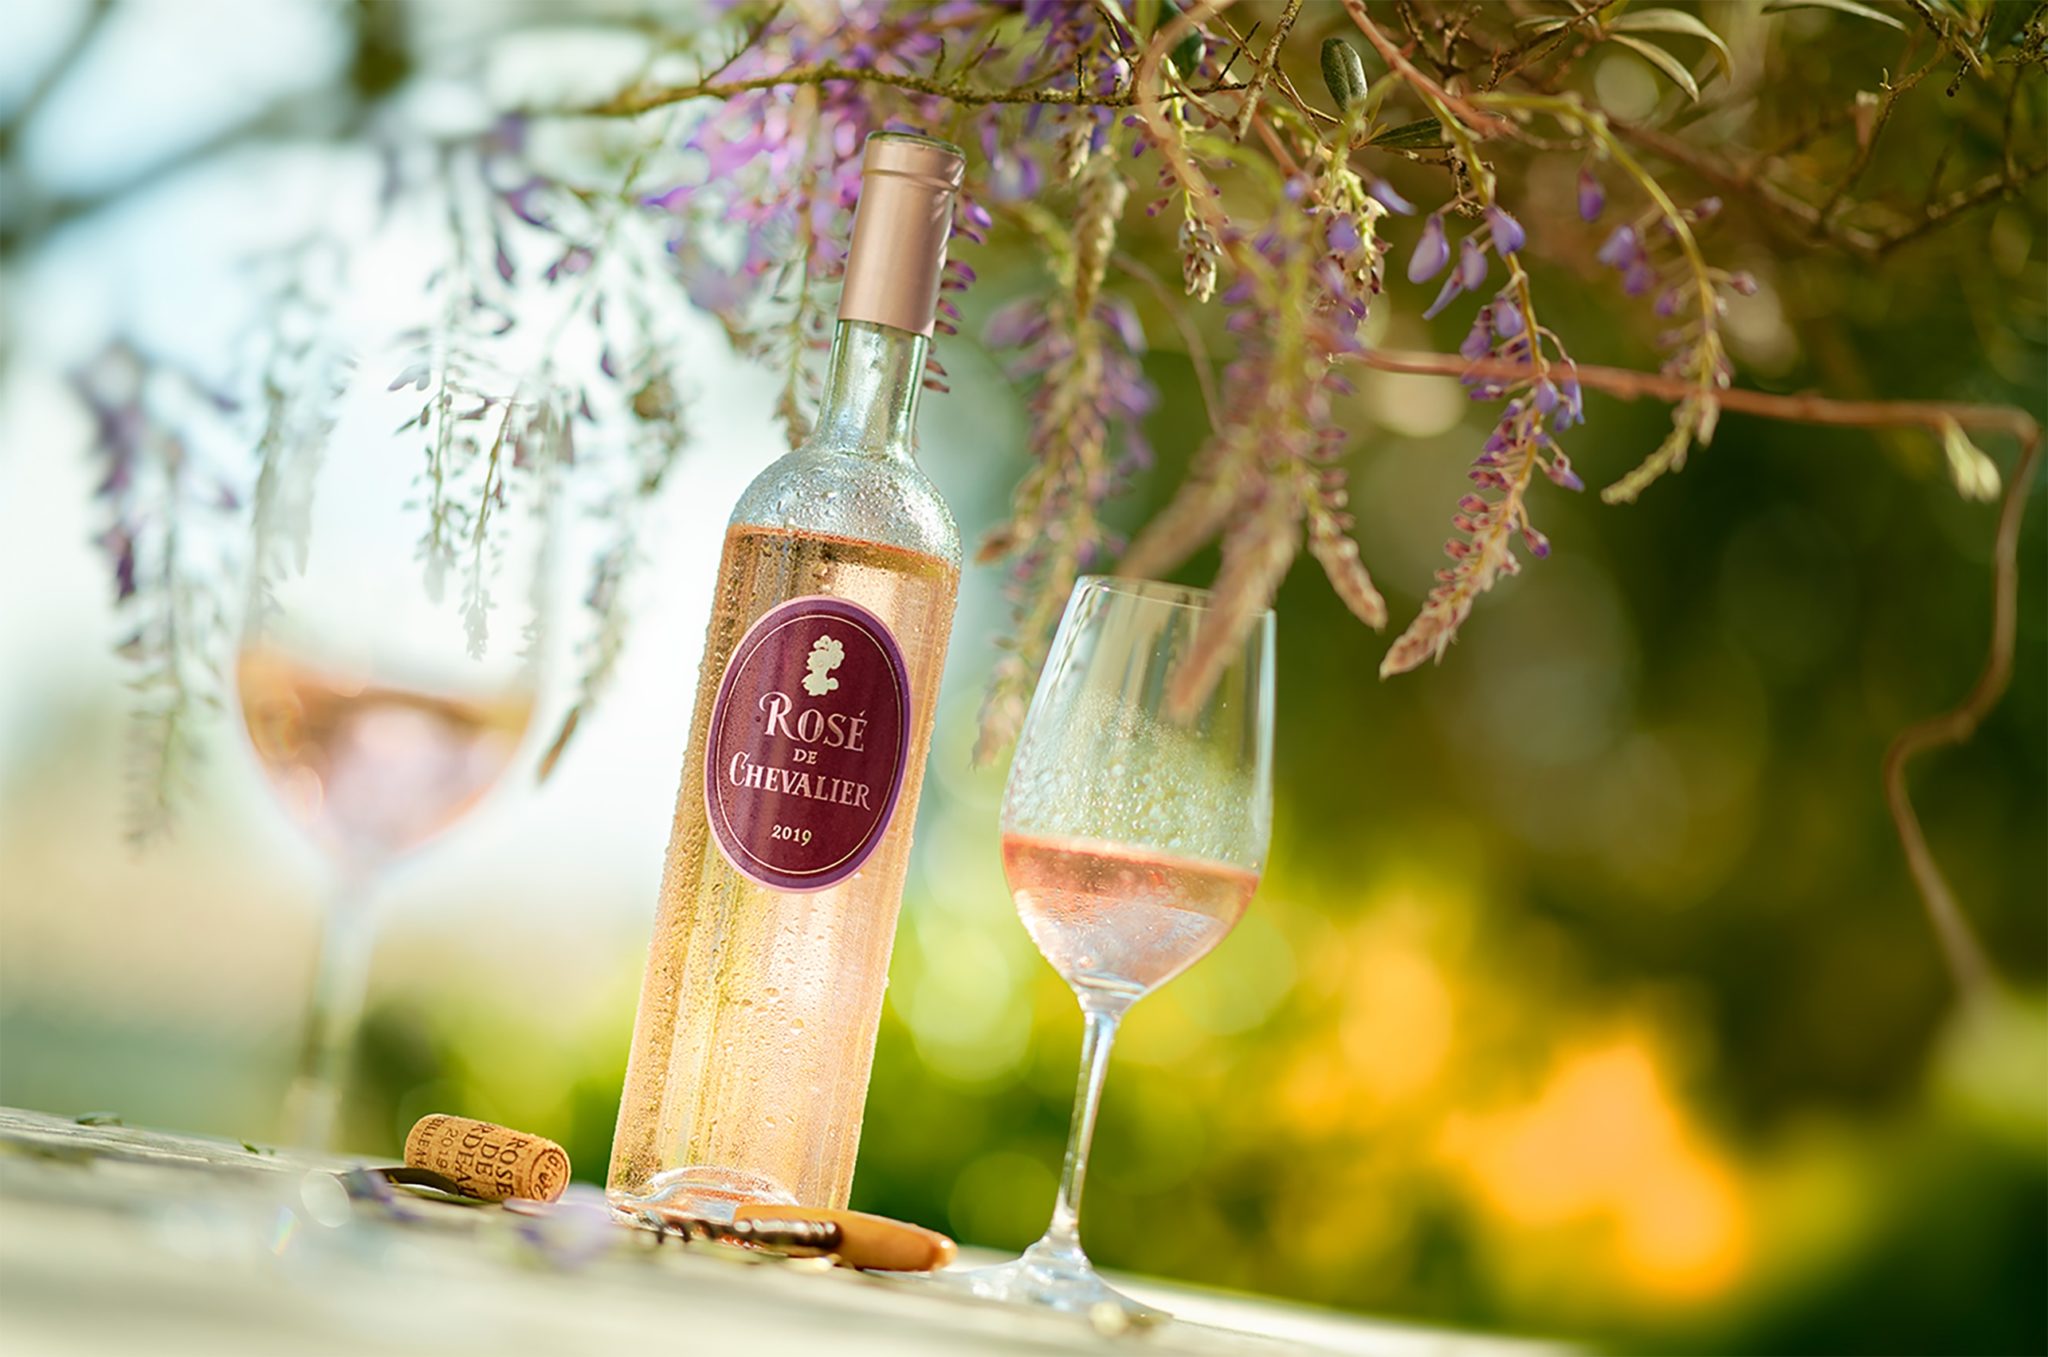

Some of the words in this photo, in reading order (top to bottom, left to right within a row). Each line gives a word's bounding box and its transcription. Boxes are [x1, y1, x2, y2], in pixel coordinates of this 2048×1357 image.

[793, 748, 818, 765] DE
[729, 751, 871, 811] CHEVALIER
[771, 824, 812, 847] 2019
[436, 1127, 459, 1169] 2019
[475, 1142, 500, 1177] DE
